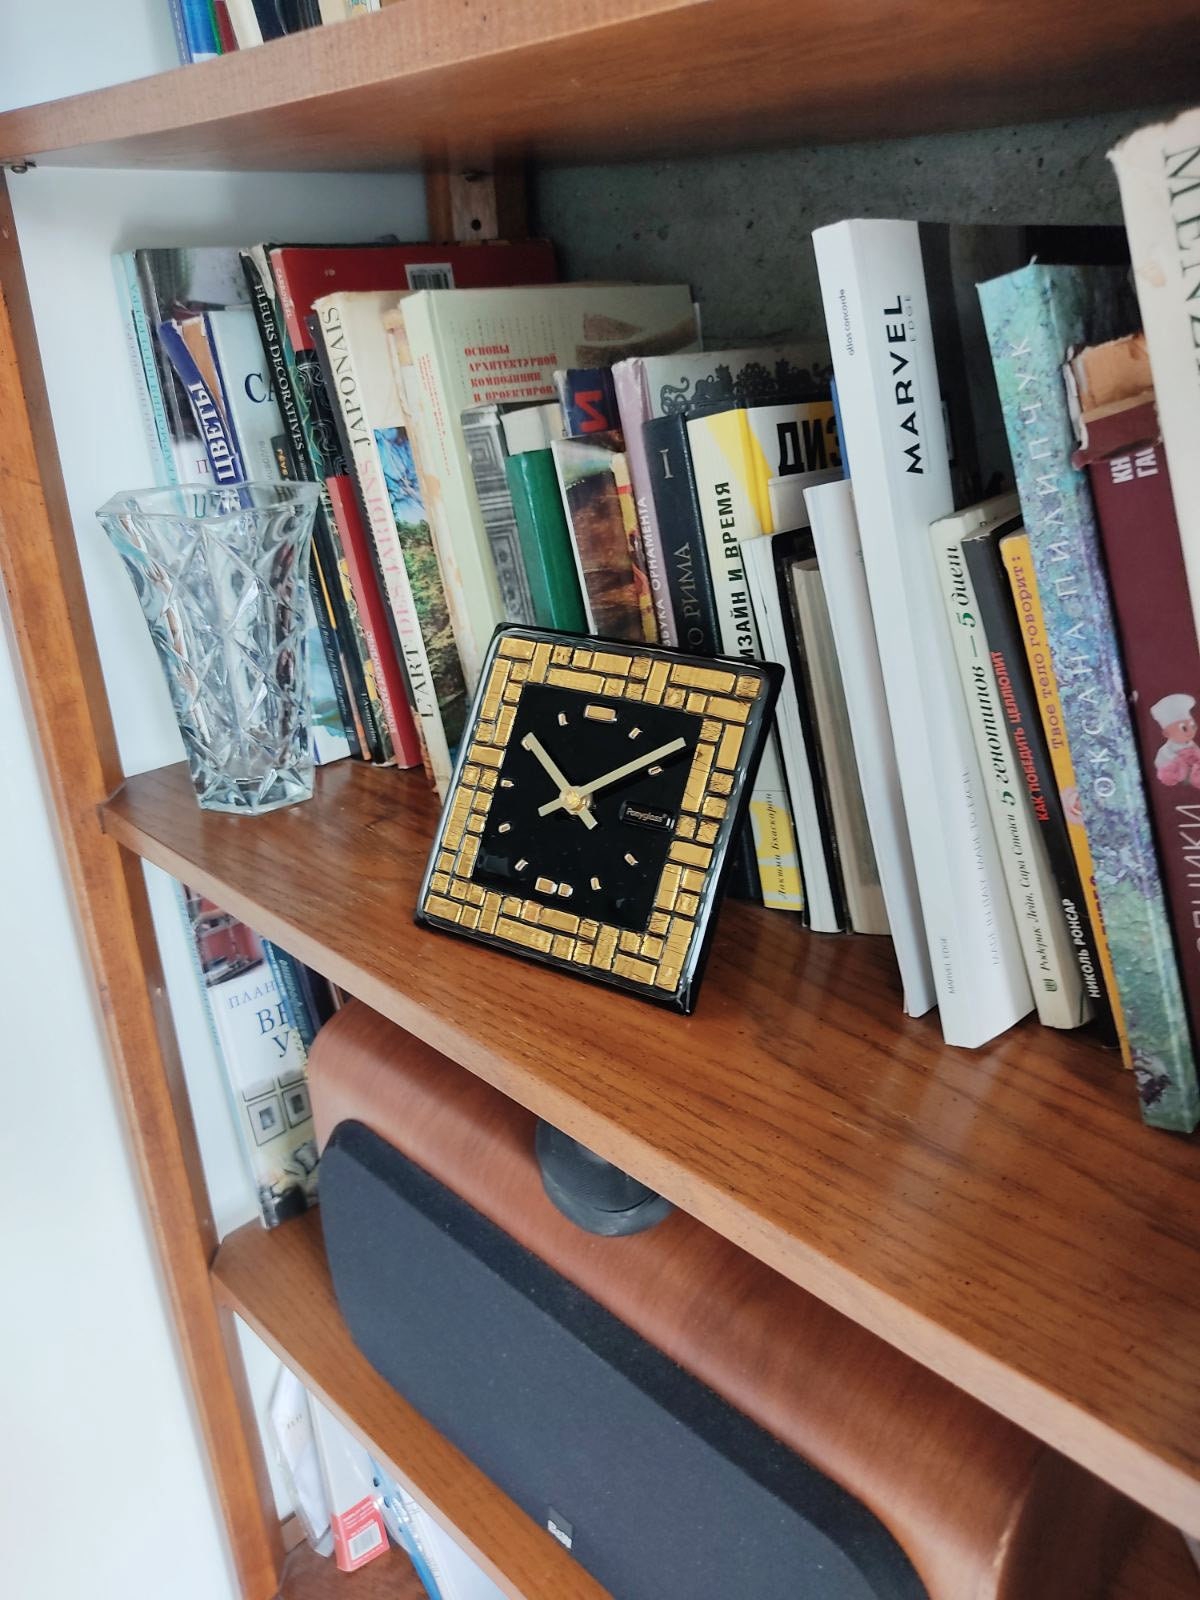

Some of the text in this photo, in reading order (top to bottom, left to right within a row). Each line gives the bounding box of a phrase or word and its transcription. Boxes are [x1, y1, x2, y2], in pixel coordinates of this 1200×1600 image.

[839, 288, 853, 332] concorde
[905, 294, 917, 344] EDGE
[254, 284, 278, 342] FLEURS
[269, 345, 305, 450] DECORATIVES
[322, 307, 370, 446] JAPONAIS
[464, 344, 510, 357] ОСНОВЫ
[469, 352, 558, 373] АРХИТЕКТУРНОЙ
[470, 371, 541, 388] КОМПОЗИЦИИ
[473, 393, 481, 403] И
[884, 295, 925, 475] MARVEL
[187, 383, 236, 481] ЦВЕТЫ
[637, 497, 662, 590] ОРНАМЕНТА
[715, 482, 740, 559] ВРЕМЯ
[673, 541, 701, 619] РИМА
[728, 567, 744, 582] И
[945, 545, 971, 607] диет
[1010, 337, 1116, 799] ОКСАНА ПИЛИПЧУК
[959, 610, 976, 628] 5
[403, 645, 434, 719] L'ART
[1033, 653, 1053, 699] тело
[972, 665, 1009, 785] генотипов
[991, 651, 1050, 822] КАК ПОБЕДИТЬ ЦЕЛЛЮЛИТ
[1046, 704, 1066, 749] Твое
[1000, 790, 1017, 807] 5
[766, 793, 788, 899] Лакшми Бхаскаран
[1004, 814, 1051, 971] Родерик Лейн, Сара Стейси
[1062, 898, 1084, 946] РОНСАР
[1078, 949, 1101, 998] НИКОЛЬ
